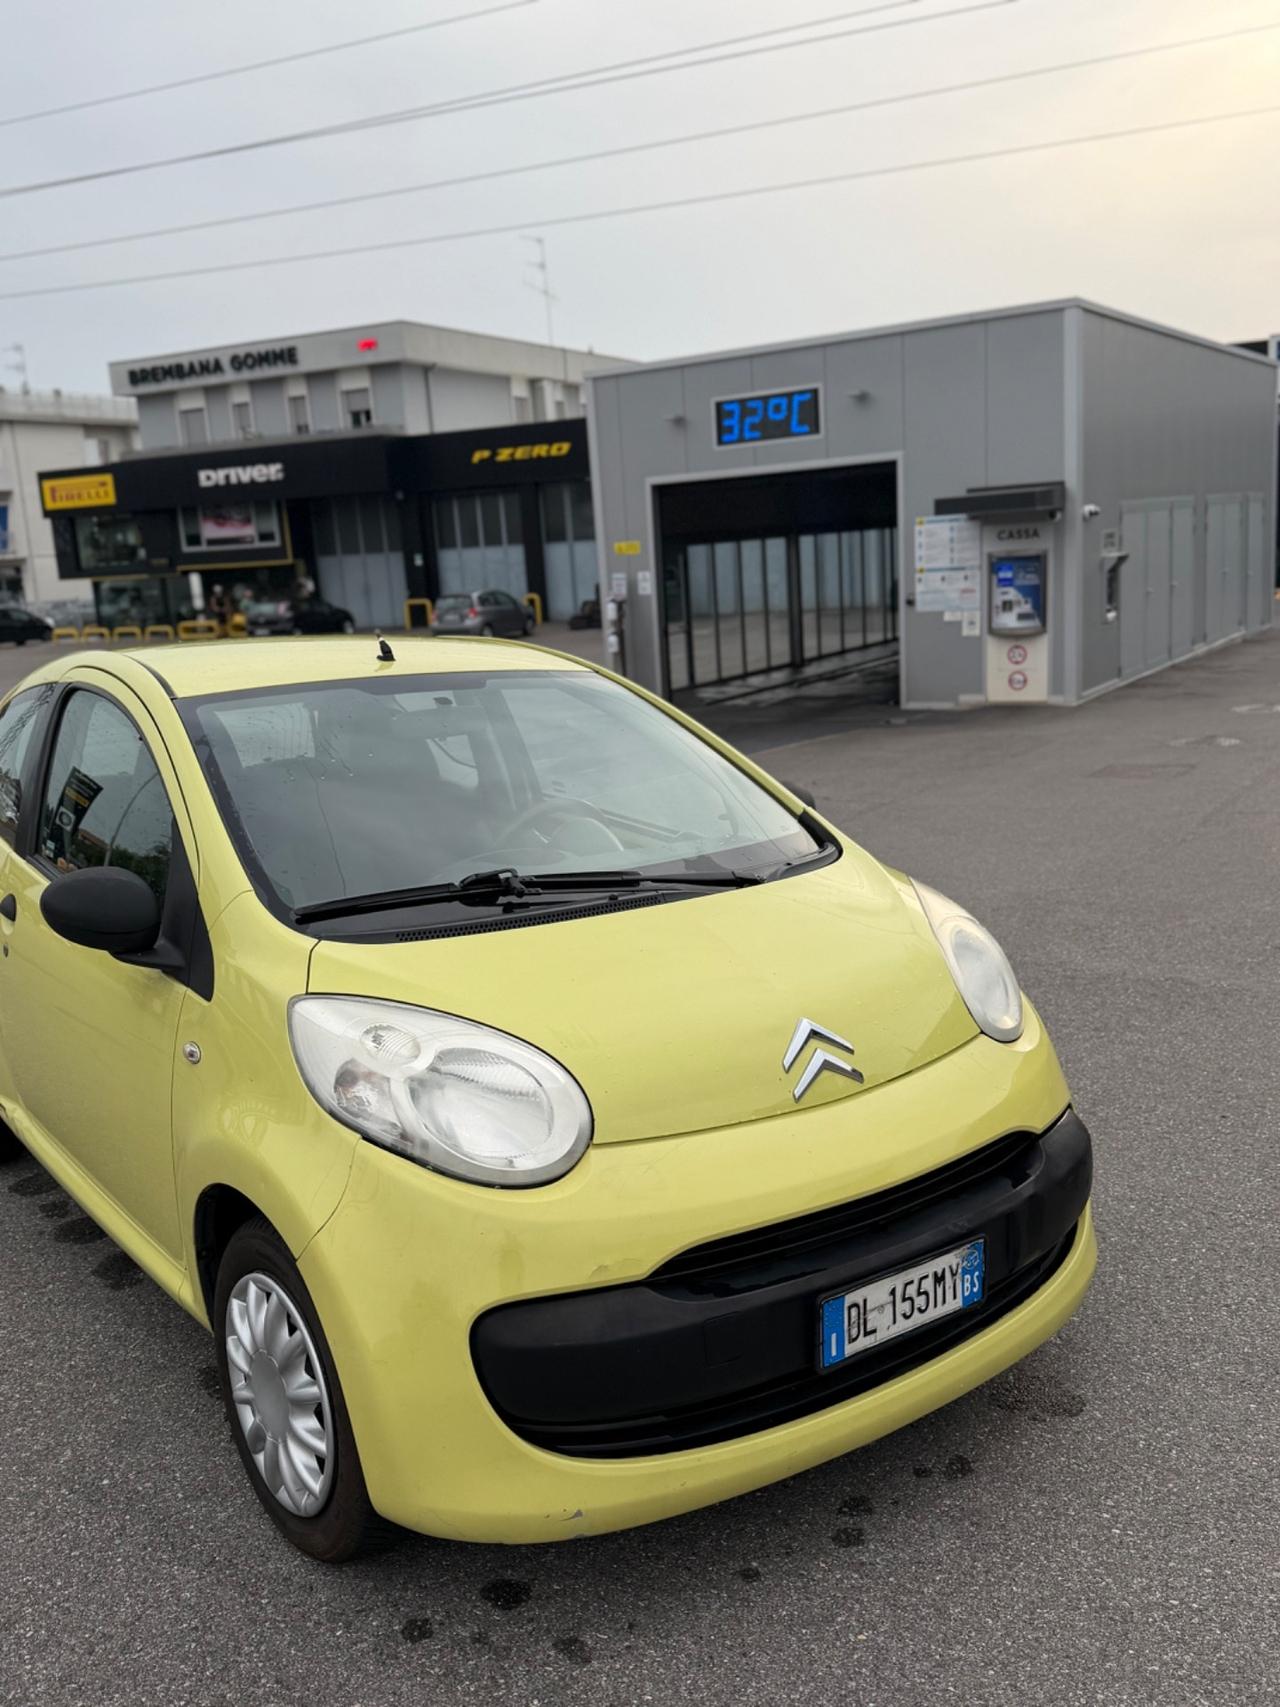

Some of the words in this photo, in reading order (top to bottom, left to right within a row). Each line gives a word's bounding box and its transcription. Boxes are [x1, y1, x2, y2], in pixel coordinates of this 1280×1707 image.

[128, 357, 224, 386] BREMBANA
[230, 345, 298, 372] GOMME
[470, 448, 492, 465] P
[495, 441, 572, 462] ZERO
[996, 527, 1040, 541] CASSA
[847, 1298, 877, 1344] DL
[888, 1262, 960, 1325] 155MY
[964, 1271, 979, 1297] BS
